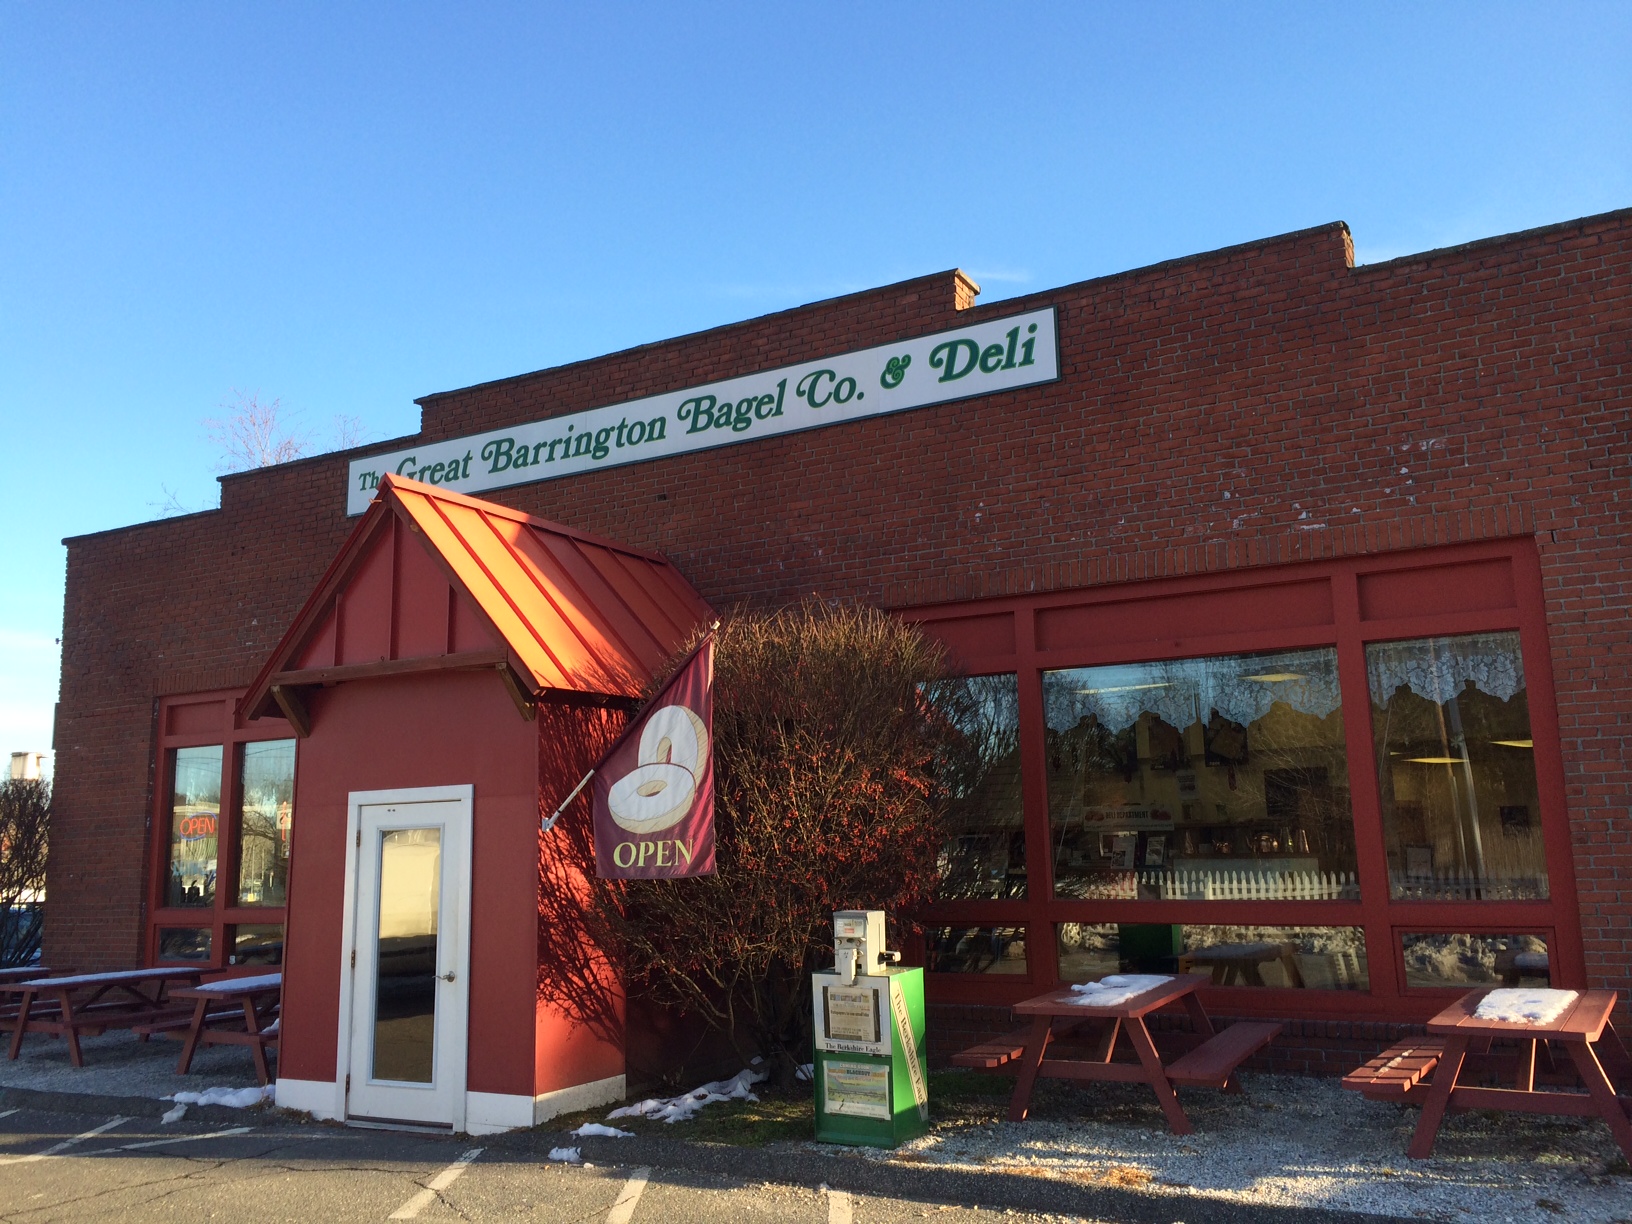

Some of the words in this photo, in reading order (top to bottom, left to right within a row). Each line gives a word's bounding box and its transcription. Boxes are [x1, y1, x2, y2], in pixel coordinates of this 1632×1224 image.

[360, 471, 386, 491] Th
[396, 450, 472, 485] Great
[481, 416, 666, 475] Barrington
[677, 378, 787, 432] Bagel
[796, 369, 864, 408] Co.
[880, 354, 911, 389] &
[928, 322, 1038, 384] Deli
[180, 818, 216, 835] OPEN
[613, 839, 694, 868] OPEN
[837, 1043, 865, 1052] Berkshire
[865, 1046, 881, 1054] Eagle
